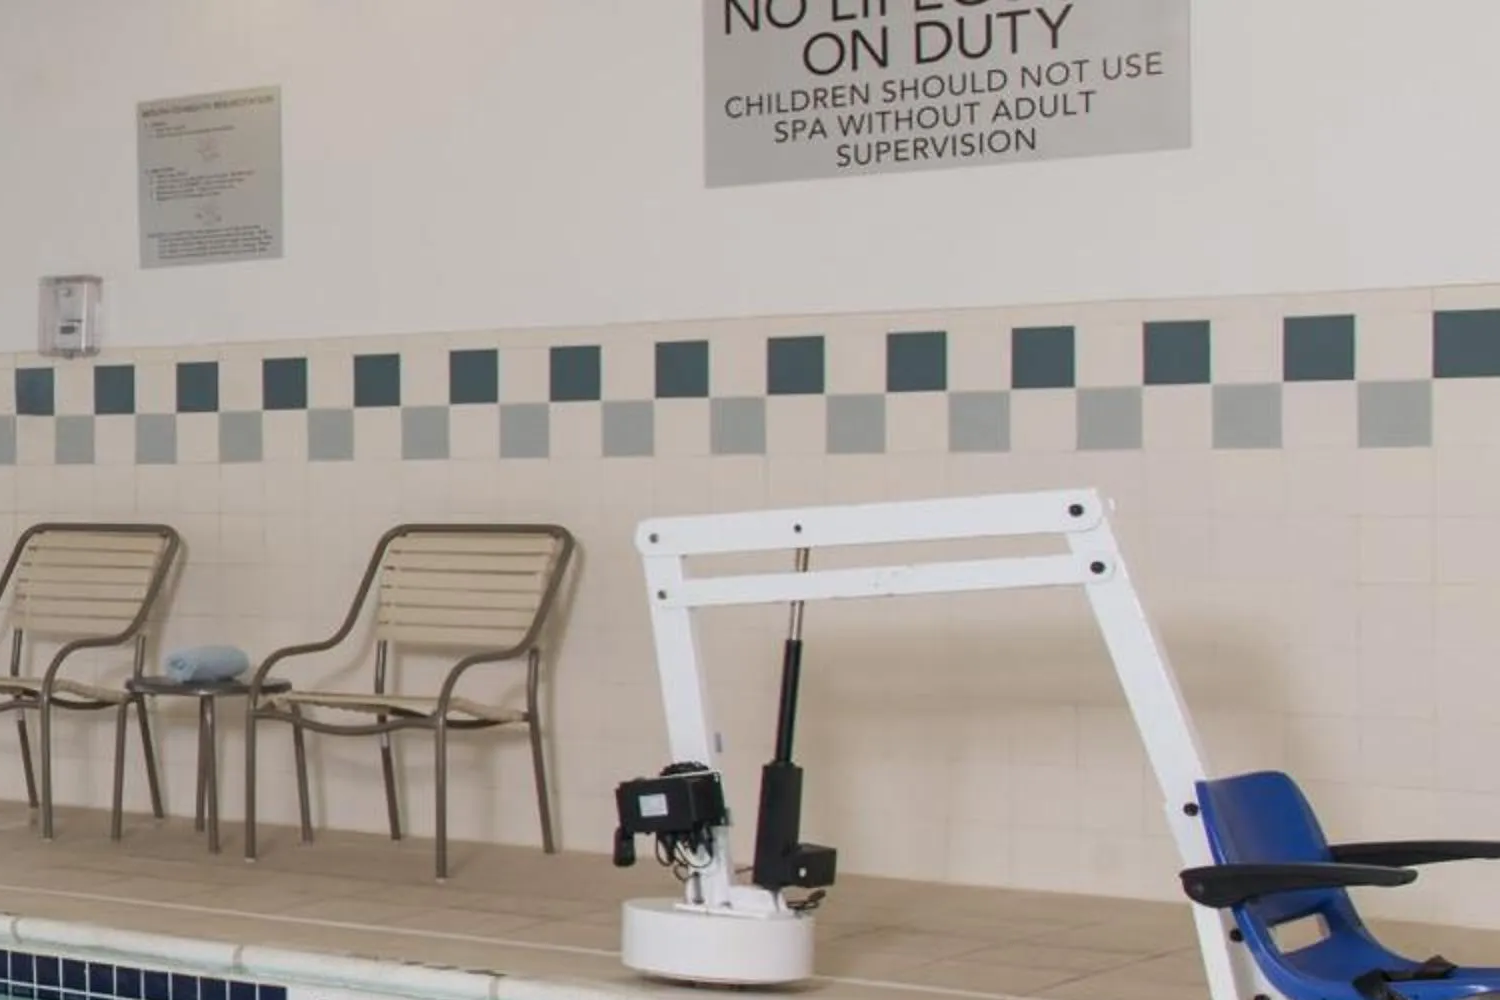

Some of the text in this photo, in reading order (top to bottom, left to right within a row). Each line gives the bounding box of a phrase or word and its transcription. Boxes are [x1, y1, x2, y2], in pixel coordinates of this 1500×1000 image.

[725, 0, 807, 35] NO
[803, 4, 1074, 76] ON DUTY
[725, 52, 1163, 118] CHILDREN SHOULD NOT USE
[774, 91, 1096, 144] SPA WITHOUT ADULT
[836, 128, 1037, 168] SUPERVISION
